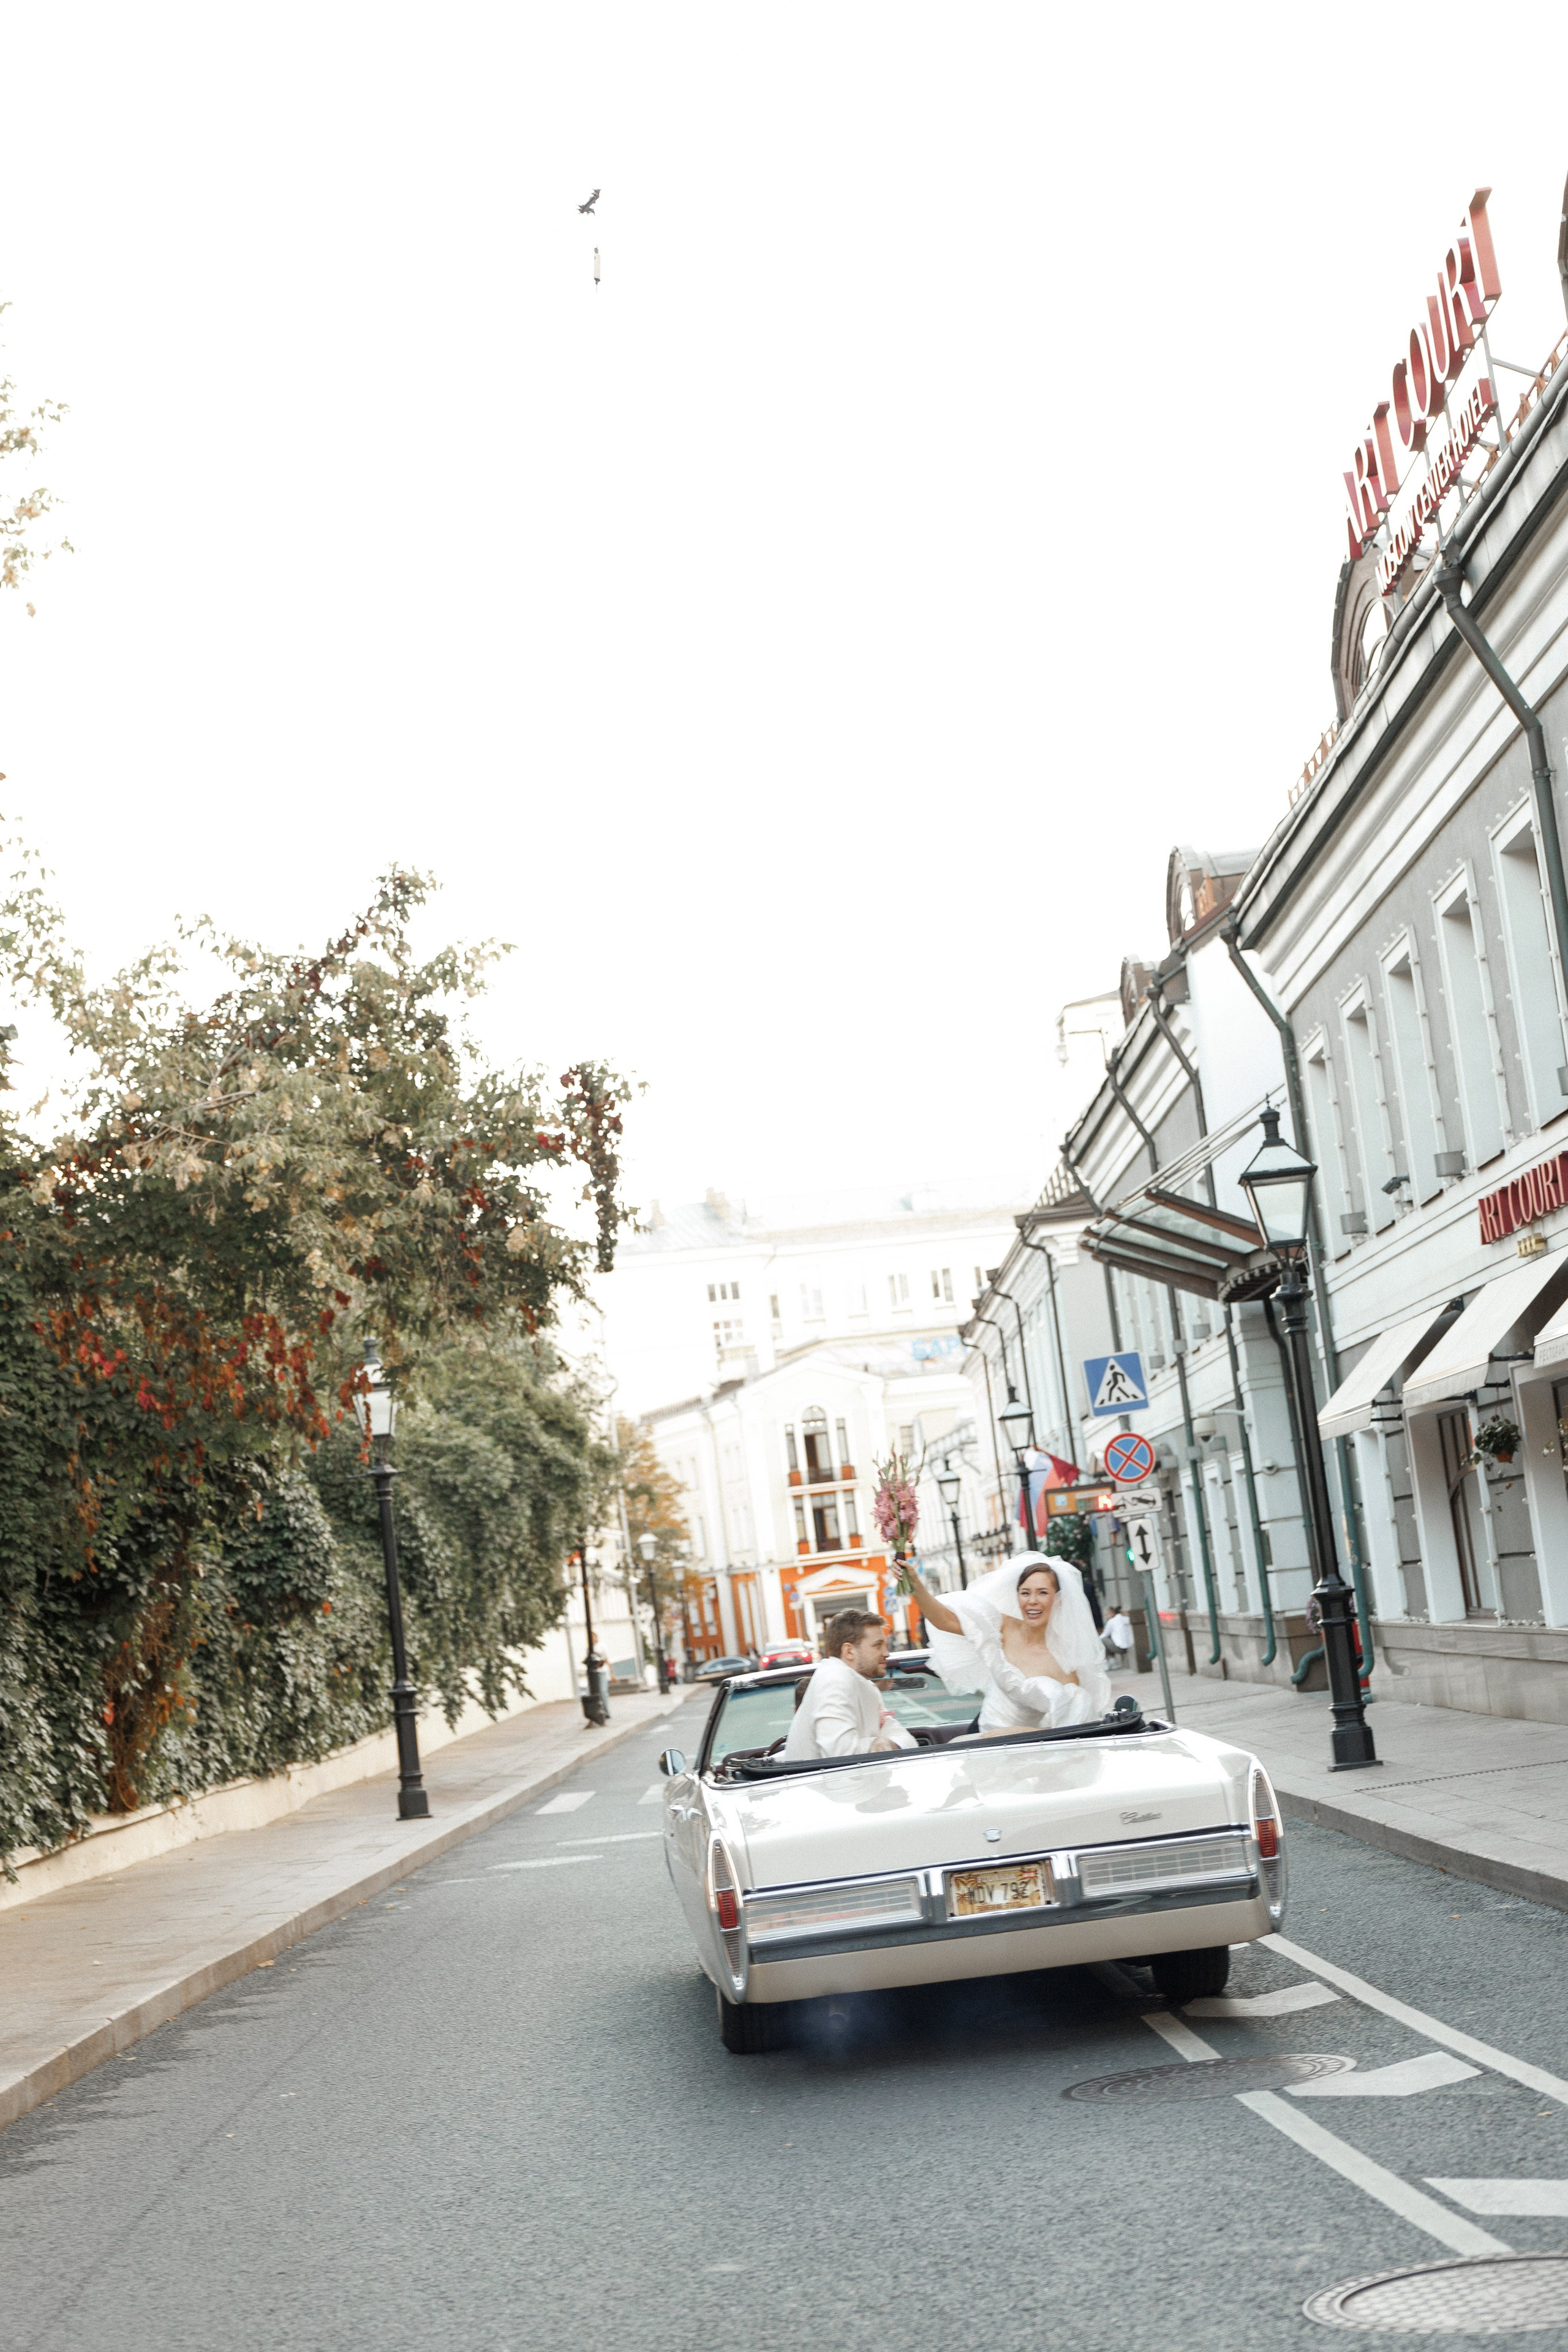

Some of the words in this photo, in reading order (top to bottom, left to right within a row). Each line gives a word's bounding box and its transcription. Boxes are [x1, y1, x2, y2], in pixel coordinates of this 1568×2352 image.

[1342, 401, 1401, 562] ART
[1393, 186, 1502, 452] COURT
[1375, 506, 1416, 596] MOSCOW
[1414, 442, 1456, 527] CENTER
[1450, 377, 1492, 463] HOTEL
[1479, 1187, 1513, 1245] ART
[1508, 1150, 1568, 1227] COURT
[911, 1336, 967, 1360] БАР
